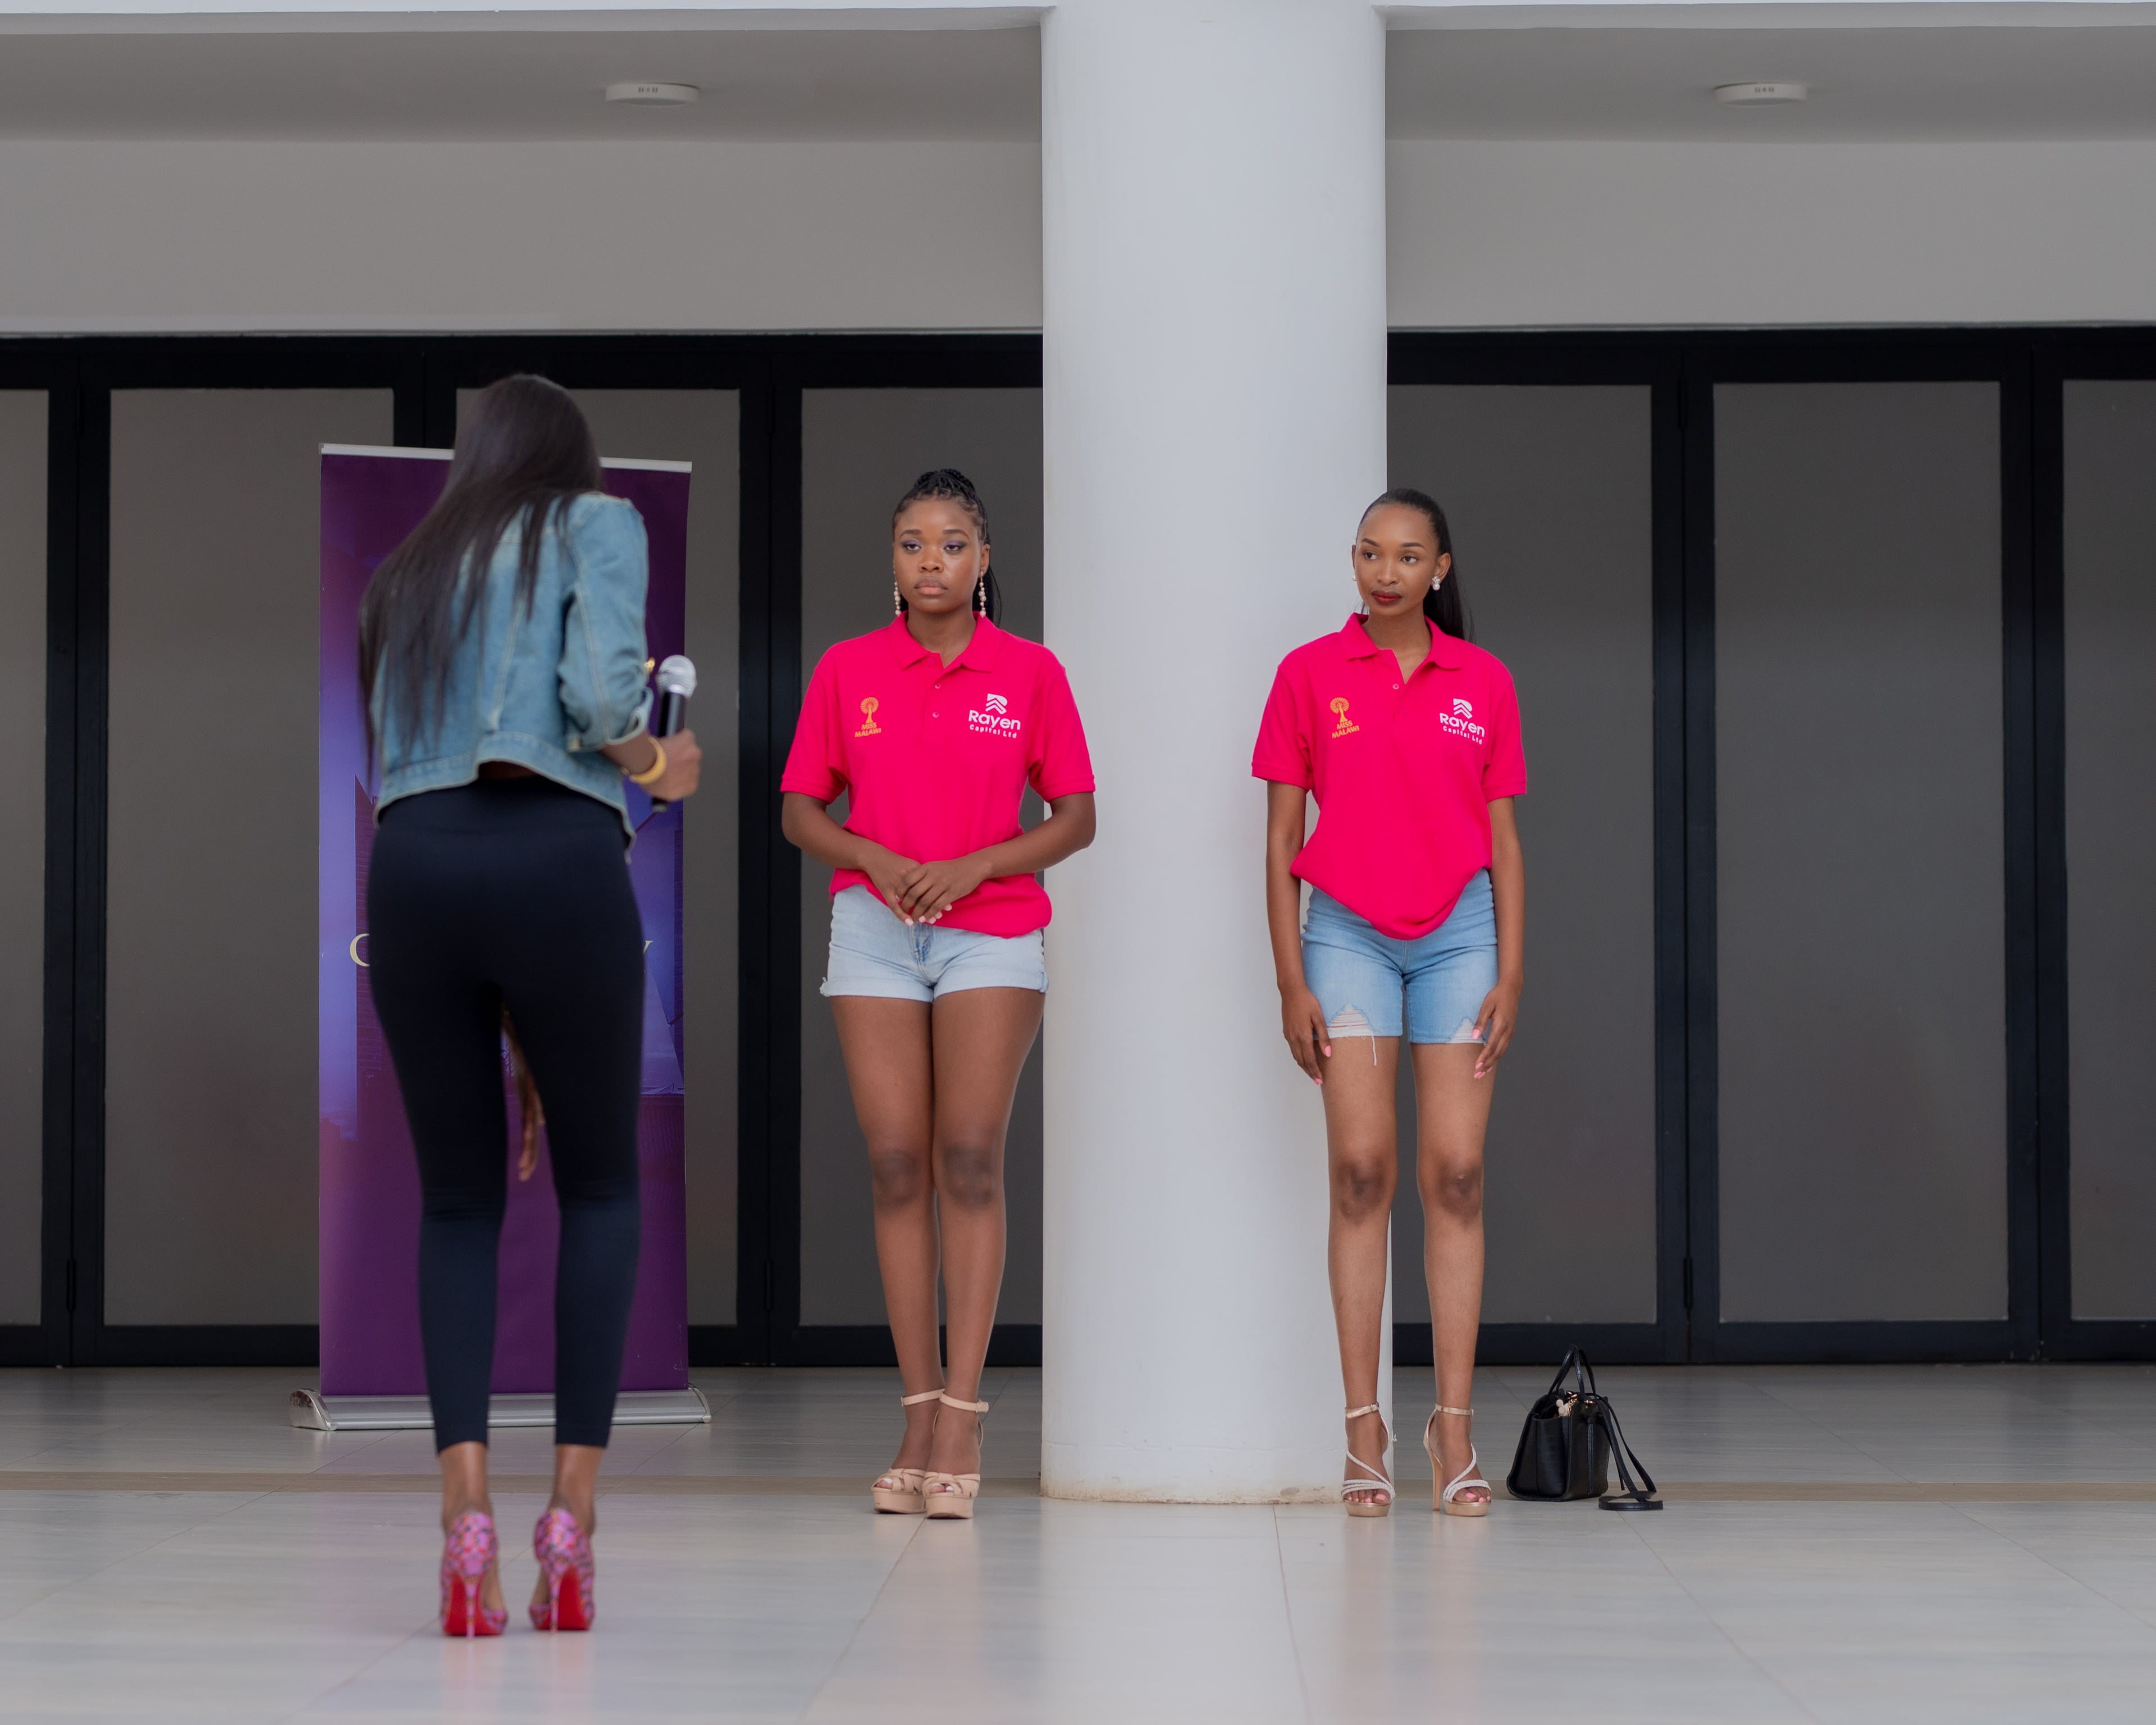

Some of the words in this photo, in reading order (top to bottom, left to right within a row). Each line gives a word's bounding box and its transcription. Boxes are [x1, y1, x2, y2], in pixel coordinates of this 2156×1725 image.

[861, 722, 877, 730] MISS
[968, 709, 1021, 731] Rayen
[1336, 720, 1353, 730] MISS
[1439, 712, 1485, 737] Rayen
[854, 727, 881, 738] MALAWI
[969, 724, 1001, 736] Capital
[1003, 730, 1017, 739] Ltd
[1331, 725, 1360, 739] MALAWI
[1442, 725, 1470, 739] Capital
[1472, 734, 1482, 745] Ltd
